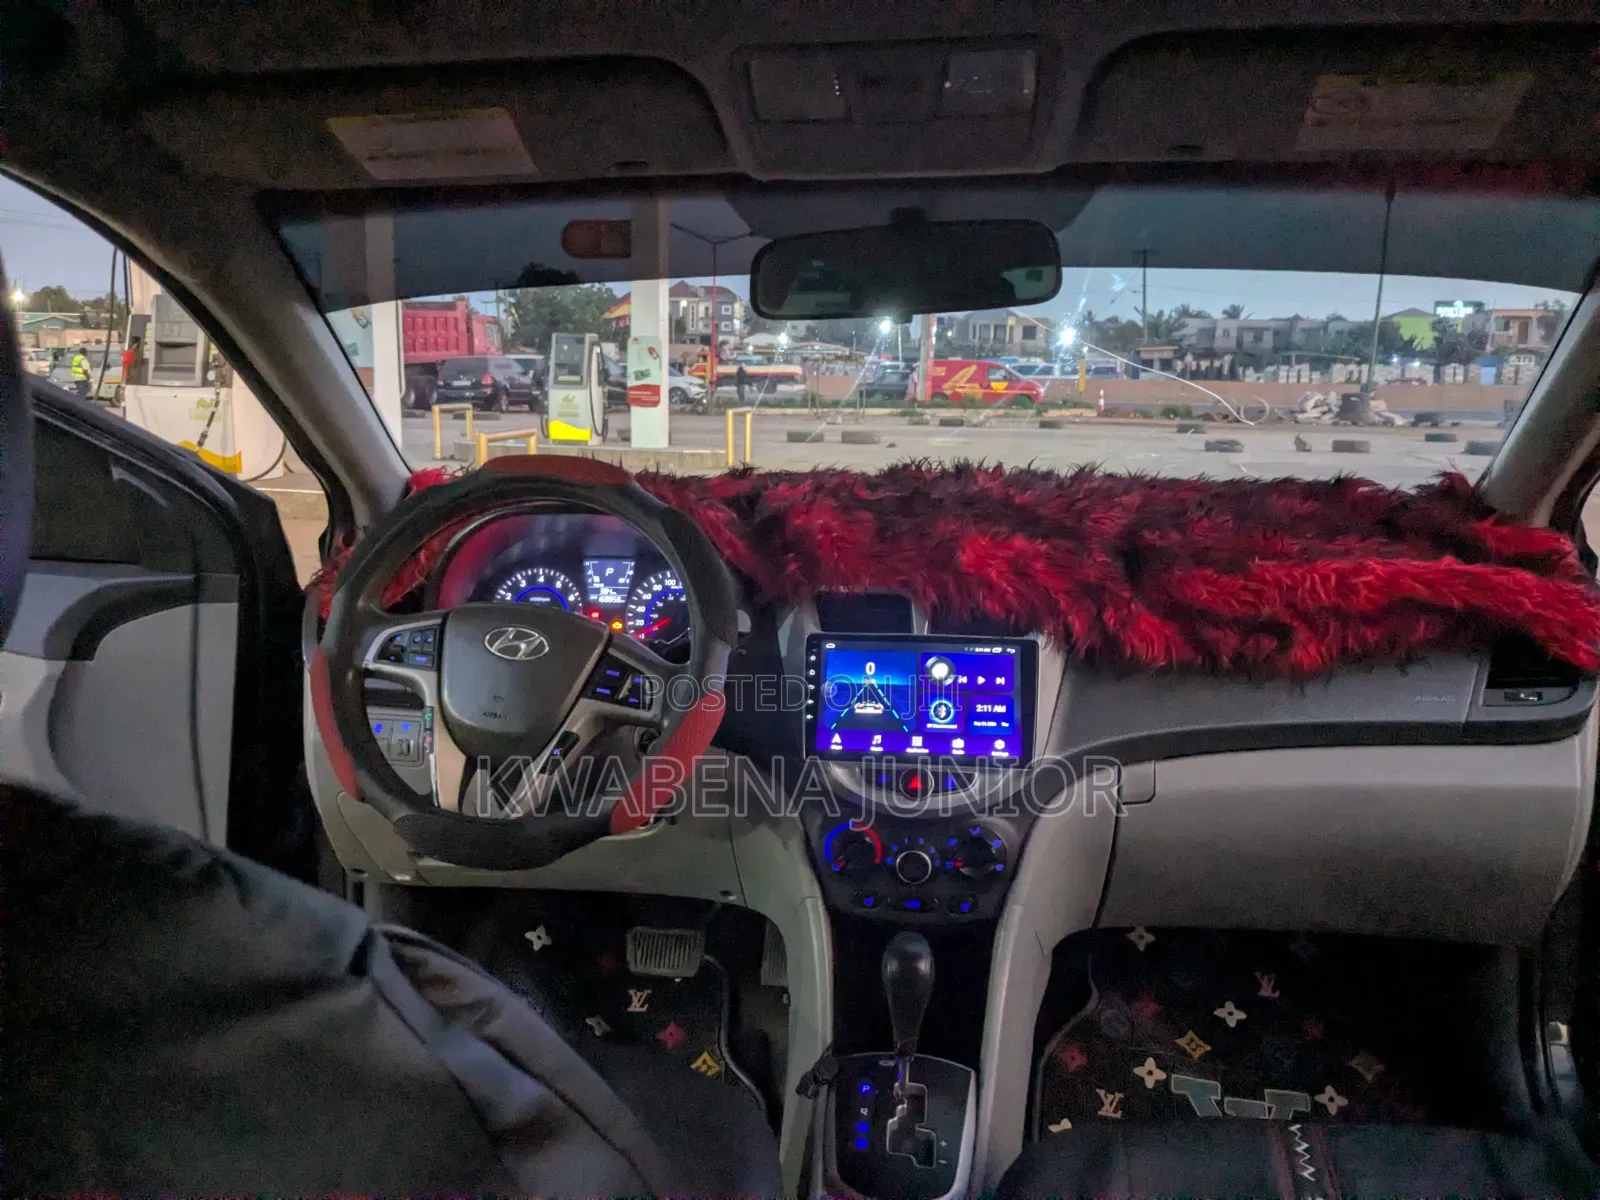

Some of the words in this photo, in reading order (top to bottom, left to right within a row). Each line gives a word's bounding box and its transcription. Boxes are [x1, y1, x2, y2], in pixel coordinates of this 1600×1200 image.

[606, 567, 614, 576] P
[520, 579, 526, 588] 3
[538, 575, 544, 583] 4
[664, 578, 676, 586] 100
[556, 580, 562, 589] 5
[505, 592, 512, 600] 2
[568, 594, 575, 602] 6
[865, 661, 876, 676] 0
[976, 704, 992, 713] 2:11
[993, 704, 1007, 713] AM
[862, 1085, 871, 1093] P
[860, 1107, 869, 1117] R
